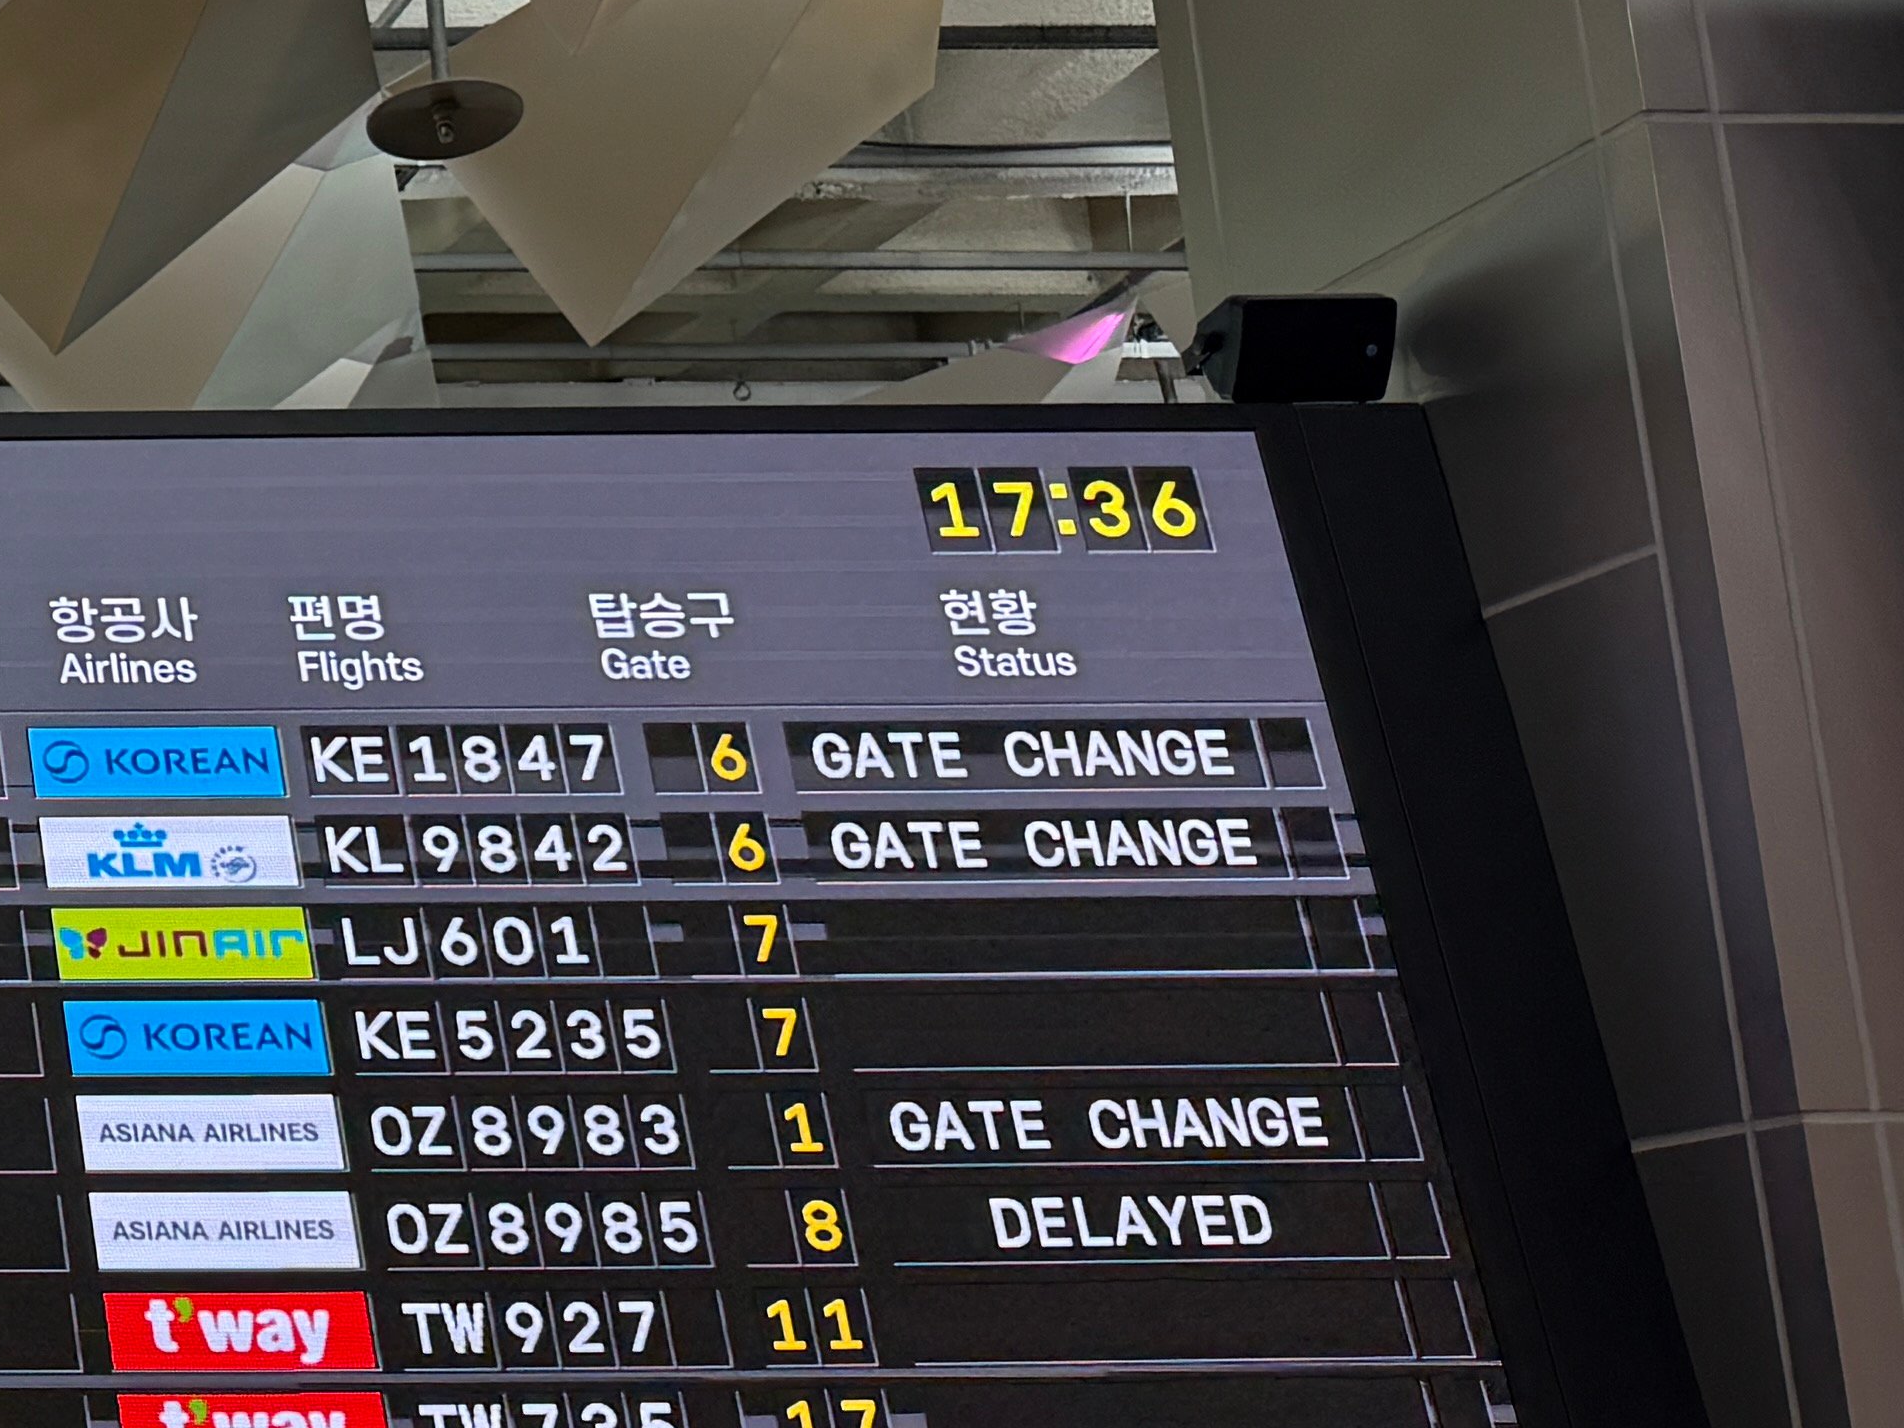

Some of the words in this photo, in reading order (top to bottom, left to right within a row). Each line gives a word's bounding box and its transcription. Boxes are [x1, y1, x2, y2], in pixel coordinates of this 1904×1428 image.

[930, 480, 1196, 538] 17:36
[49, 596, 199, 643] 항공사
[287, 595, 385, 641] 편명
[588, 592, 734, 639] 탑승구
[939, 588, 1037, 636] 현황
[60, 652, 197, 684] Airlines
[297, 650, 424, 691] Flights
[601, 647, 691, 680] Gate
[954, 645, 1077, 677] Status
[104, 746, 269, 776] KOREAN
[310, 734, 604, 786] KE1847
[710, 733, 747, 781] 6
[812, 731, 968, 779] GATE
[1004, 729, 1235, 777] CHANGE
[88, 849, 203, 878] KLM
[324, 824, 627, 873] KL9842
[728, 823, 766, 871] 6
[830, 821, 988, 869] GATE
[1024, 818, 1258, 867] CHANGE
[112, 1221, 208, 1242] ASIANA
[217, 1219, 334, 1242] AIRLINES
[386, 1201, 698, 1255] OZ8985
[801, 1199, 843, 1252] 8
[988, 1194, 1272, 1248] DELAYED
